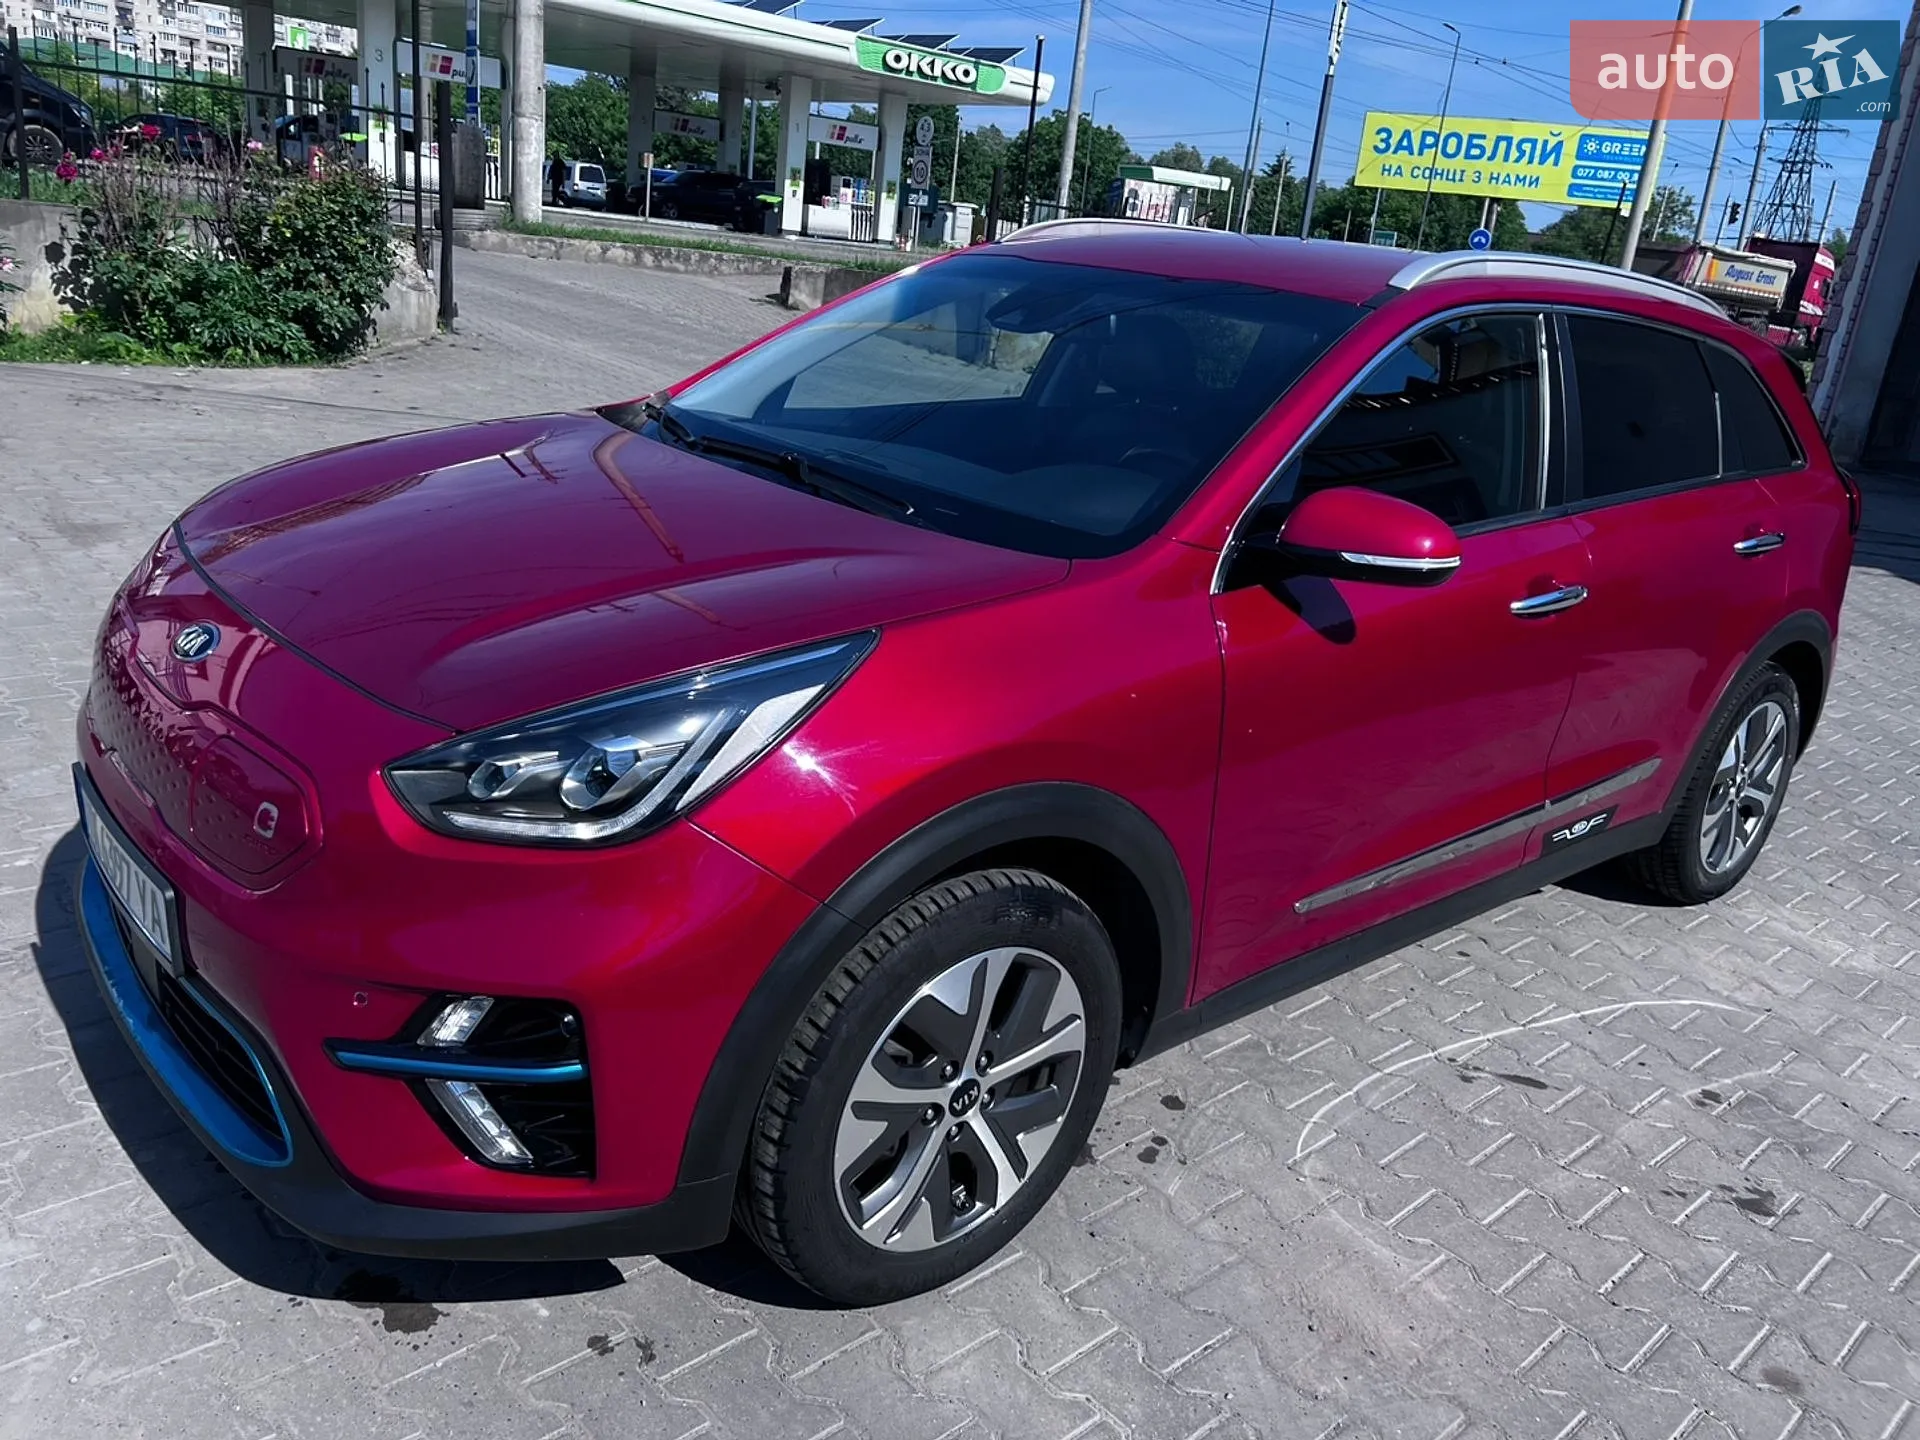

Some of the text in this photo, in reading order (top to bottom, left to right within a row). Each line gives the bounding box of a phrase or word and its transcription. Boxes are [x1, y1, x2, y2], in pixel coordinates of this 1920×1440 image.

[374, 49, 385, 63] 3
[885, 49, 978, 84] OKKO
[1372, 126, 1566, 167] ЗАРОБЛЯЙ
[1380, 163, 1404, 177] НА
[1410, 165, 1466, 184] СОНЦІ
[1488, 171, 1540, 189] НАМИ
[952, 1085, 979, 1110] KIA
